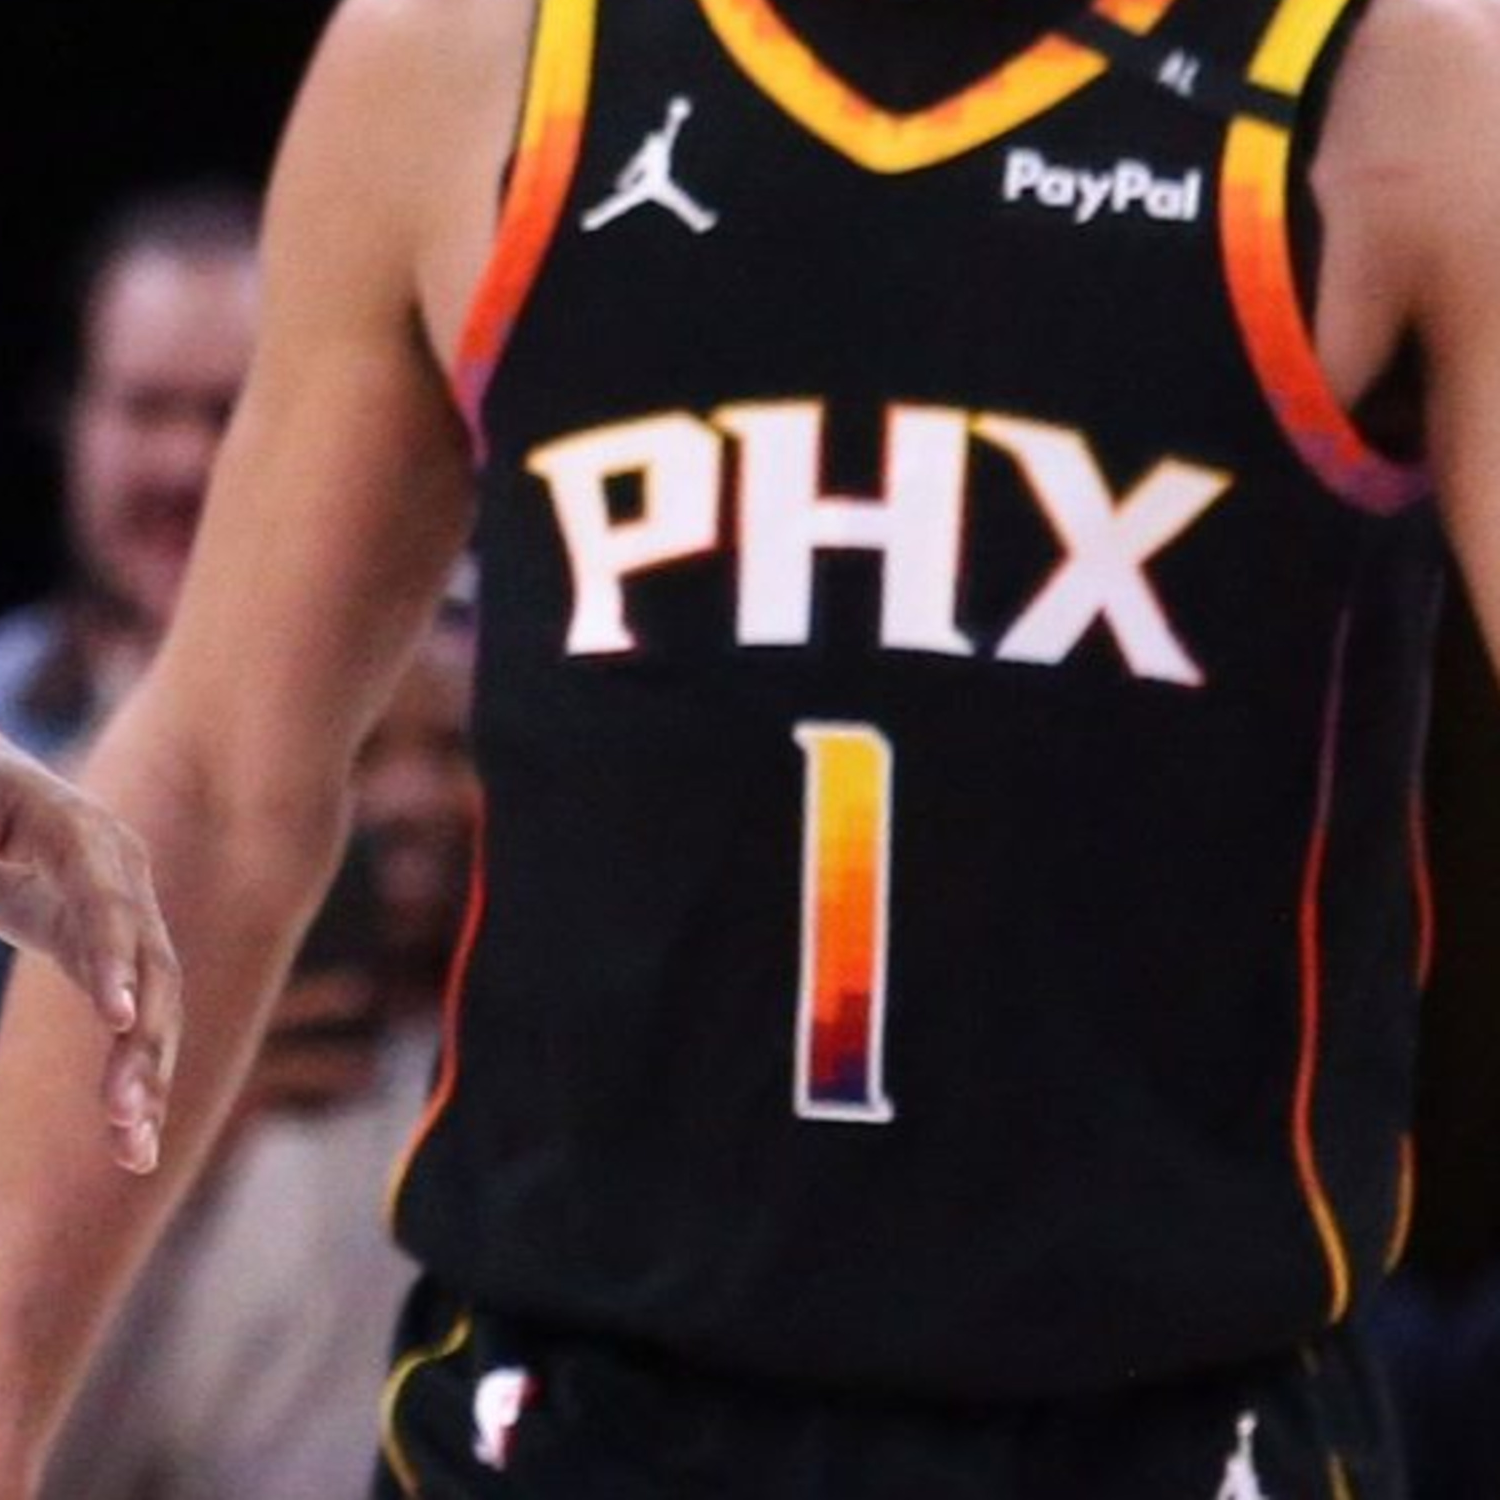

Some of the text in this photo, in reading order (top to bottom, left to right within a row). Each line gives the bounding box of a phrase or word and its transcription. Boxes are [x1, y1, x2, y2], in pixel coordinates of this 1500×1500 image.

[1003, 148, 1201, 224] PayPal
[526, 398, 1237, 688] PHX
[793, 719, 894, 1125] 1
